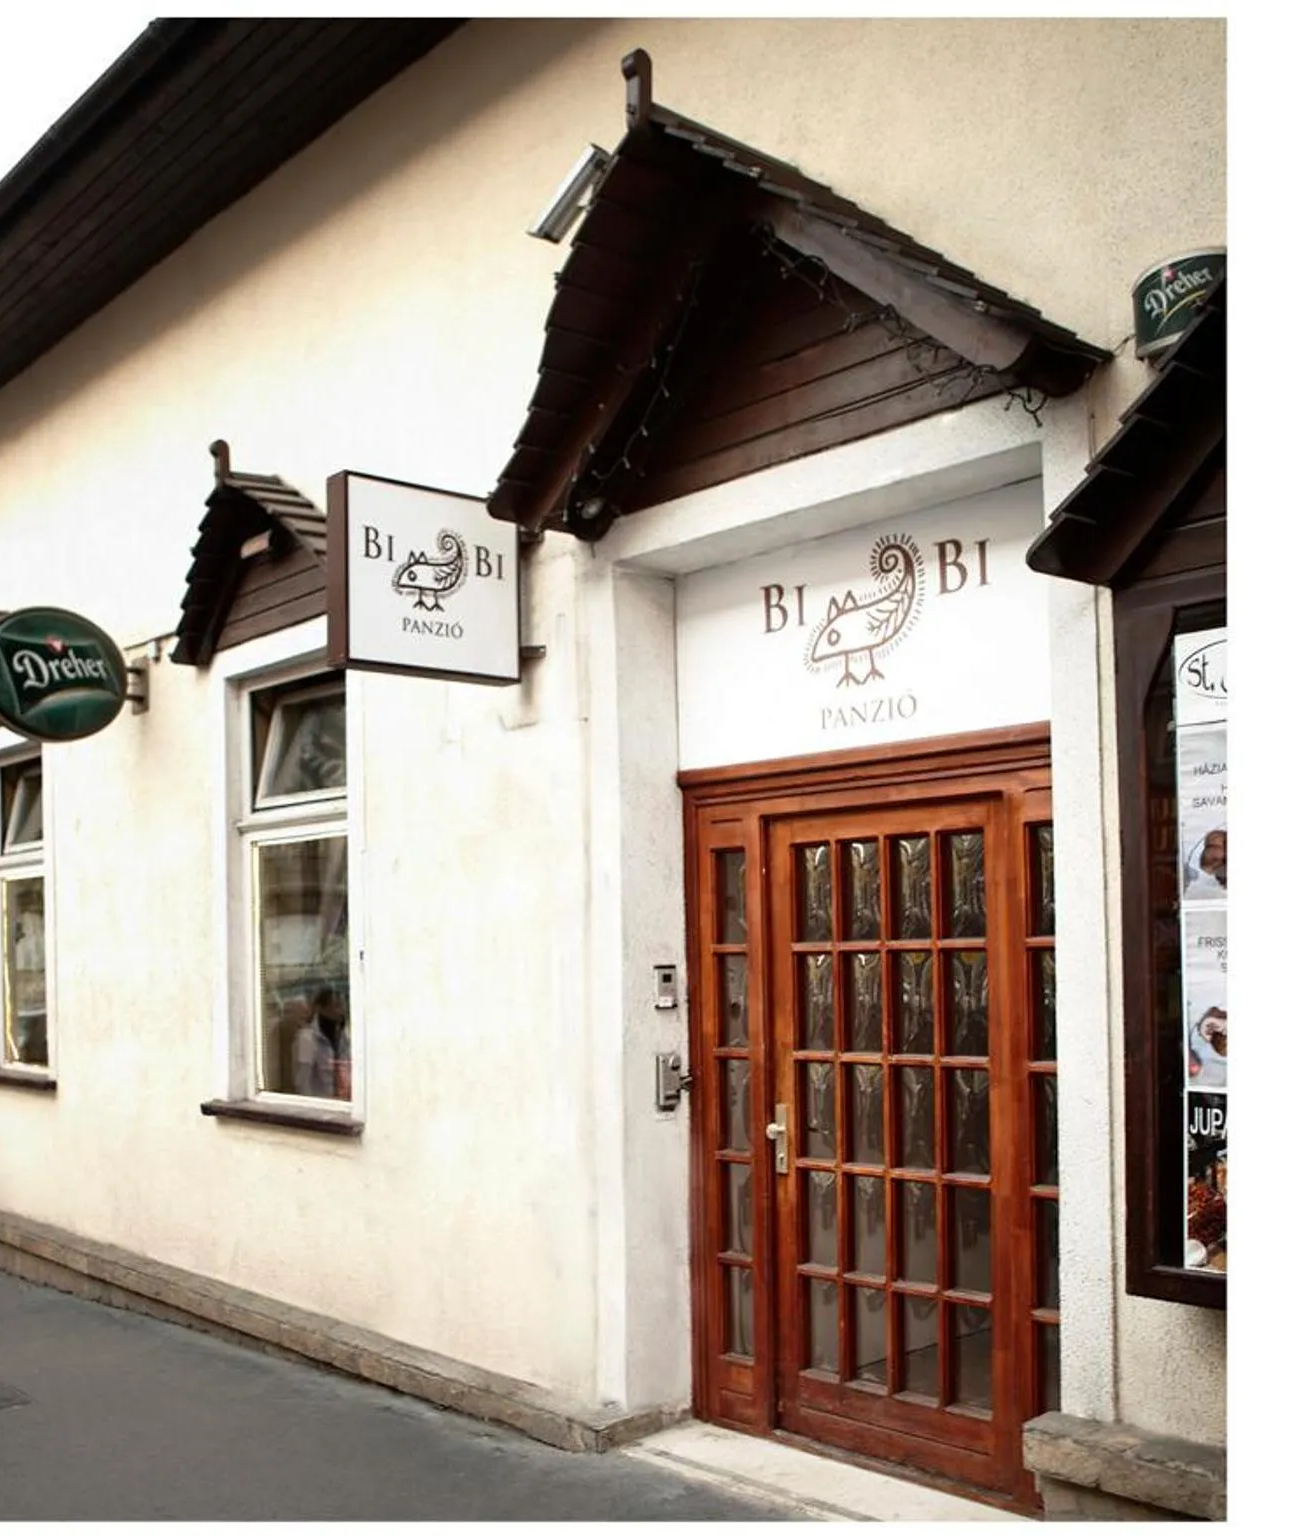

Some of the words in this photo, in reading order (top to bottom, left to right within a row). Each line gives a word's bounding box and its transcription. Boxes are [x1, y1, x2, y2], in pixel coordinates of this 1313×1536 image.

[1144, 267, 1213, 319] Dreher
[402, 616, 464, 640] PANZIÓ
[13, 648, 108, 690] Dreher
[820, 688, 918, 730] PANZIÓ
